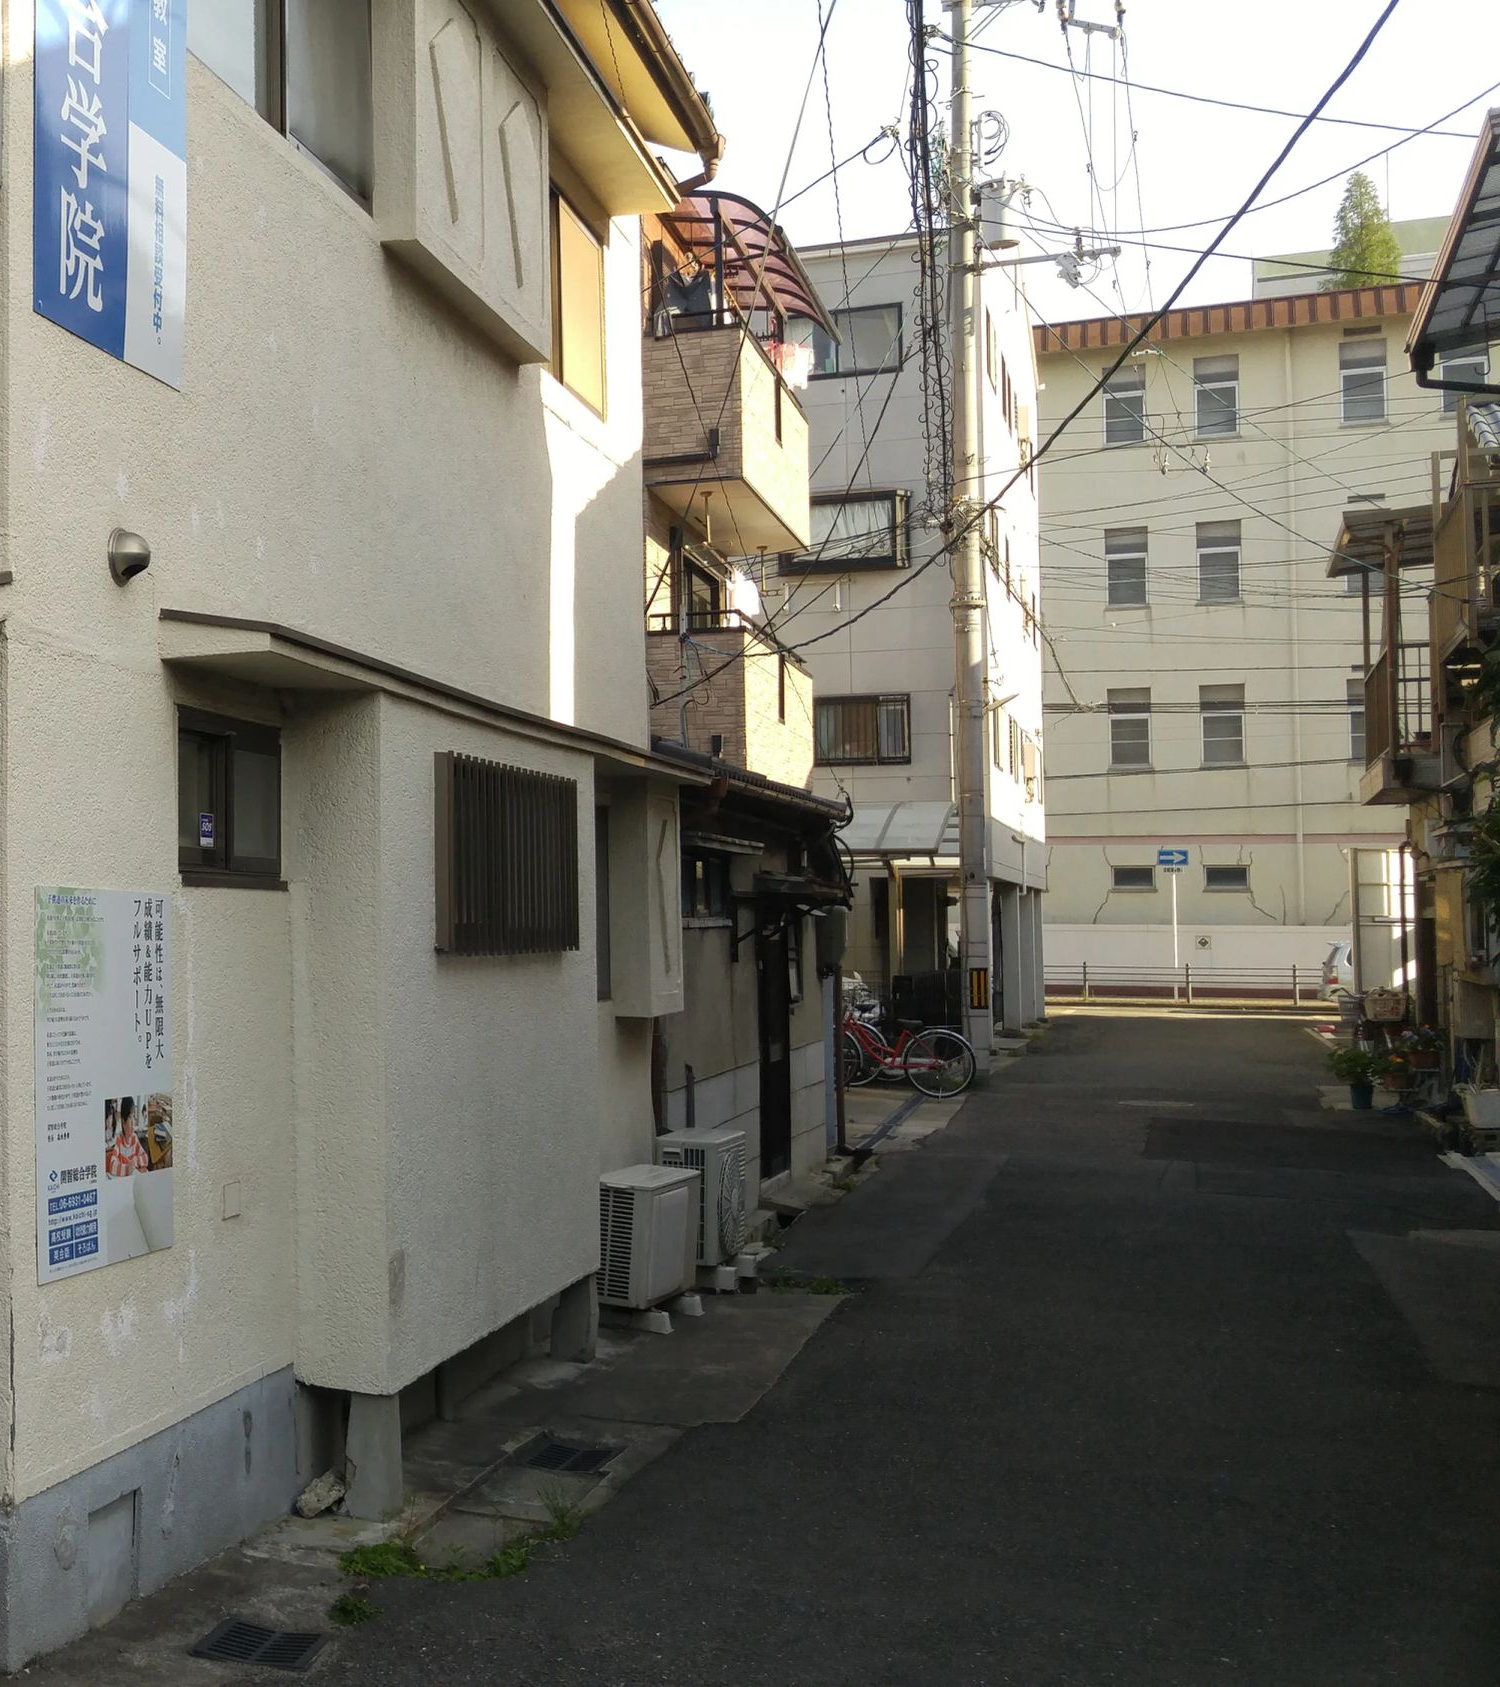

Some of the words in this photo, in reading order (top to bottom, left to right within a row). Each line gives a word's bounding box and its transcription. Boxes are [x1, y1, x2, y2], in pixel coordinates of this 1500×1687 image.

[132, 899, 142, 1043] フルサポート。
[154, 898, 165, 1060] 可能性は、無限大
